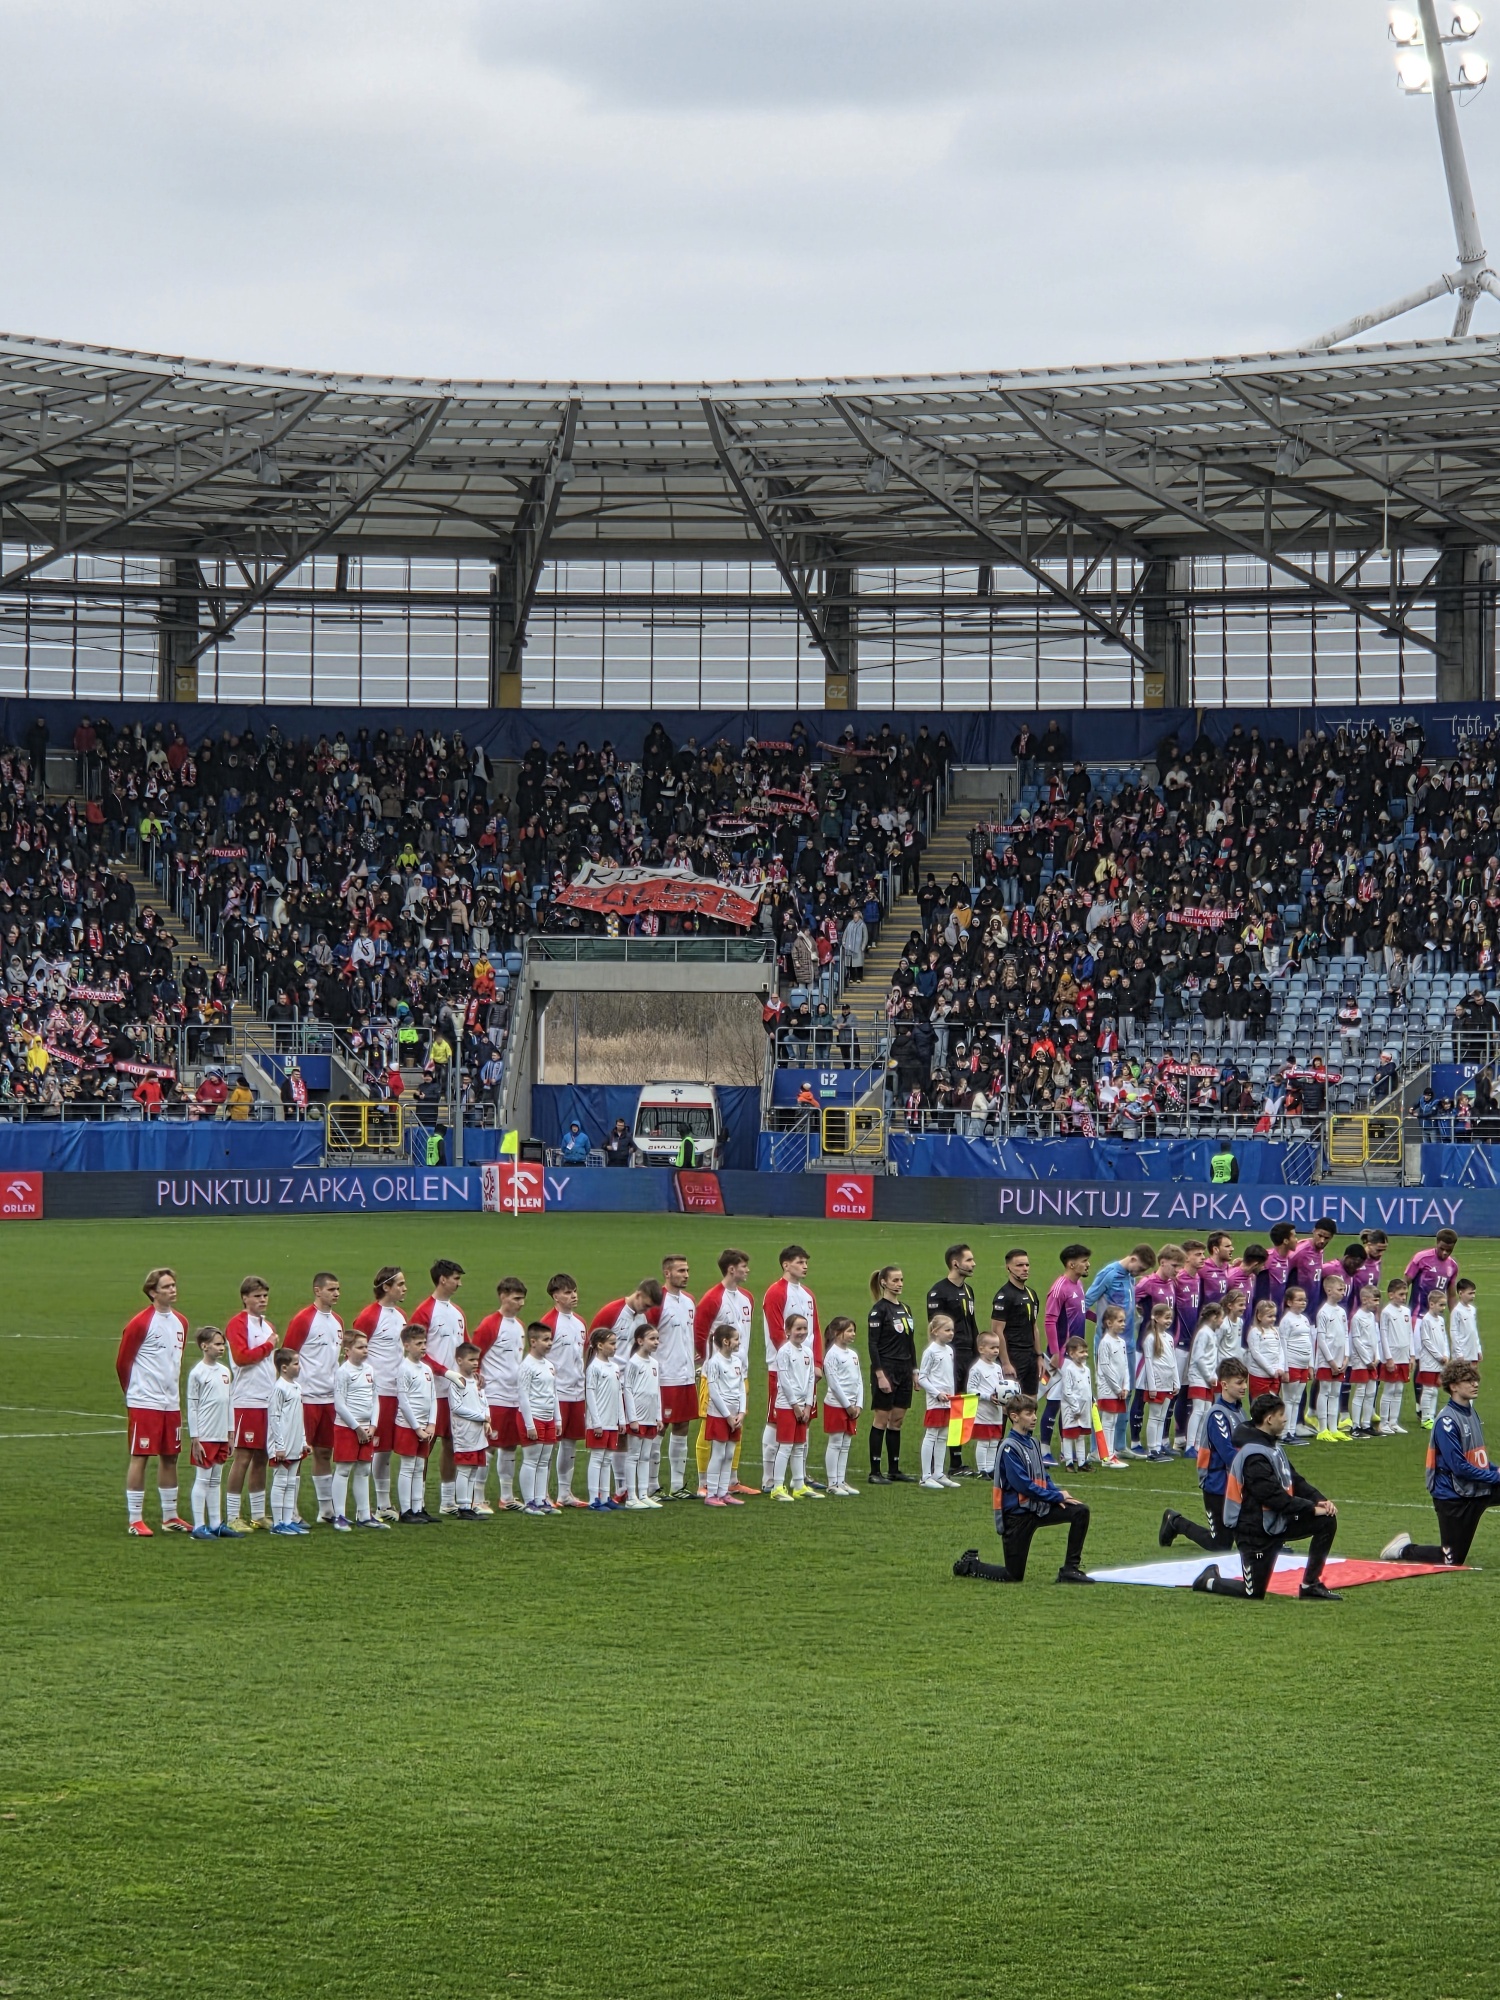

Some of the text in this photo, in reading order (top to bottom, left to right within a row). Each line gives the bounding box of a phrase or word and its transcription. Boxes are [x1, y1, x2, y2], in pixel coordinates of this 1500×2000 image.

[827, 686, 847, 698] G2
[1145, 684, 1163, 697] G2
[1198, 910, 1224, 918] POLSKA
[1464, 1066, 1479, 1078] G3
[821, 1073, 838, 1085] G2
[158, 1179, 270, 1206] PUNKTUJ
[278, 1178, 294, 1204] Z
[300, 1177, 366, 1208] APKĄ
[372, 1176, 469, 1202] ORLEN
[3, 1204, 35, 1213] ORLEN
[832, 1204, 866, 1214] ORLEN
[1000, 1188, 1463, 1227] PUNKTUJ Z APKĄ ORLEN VITAY
[1436, 1275, 1448, 1289] 19
